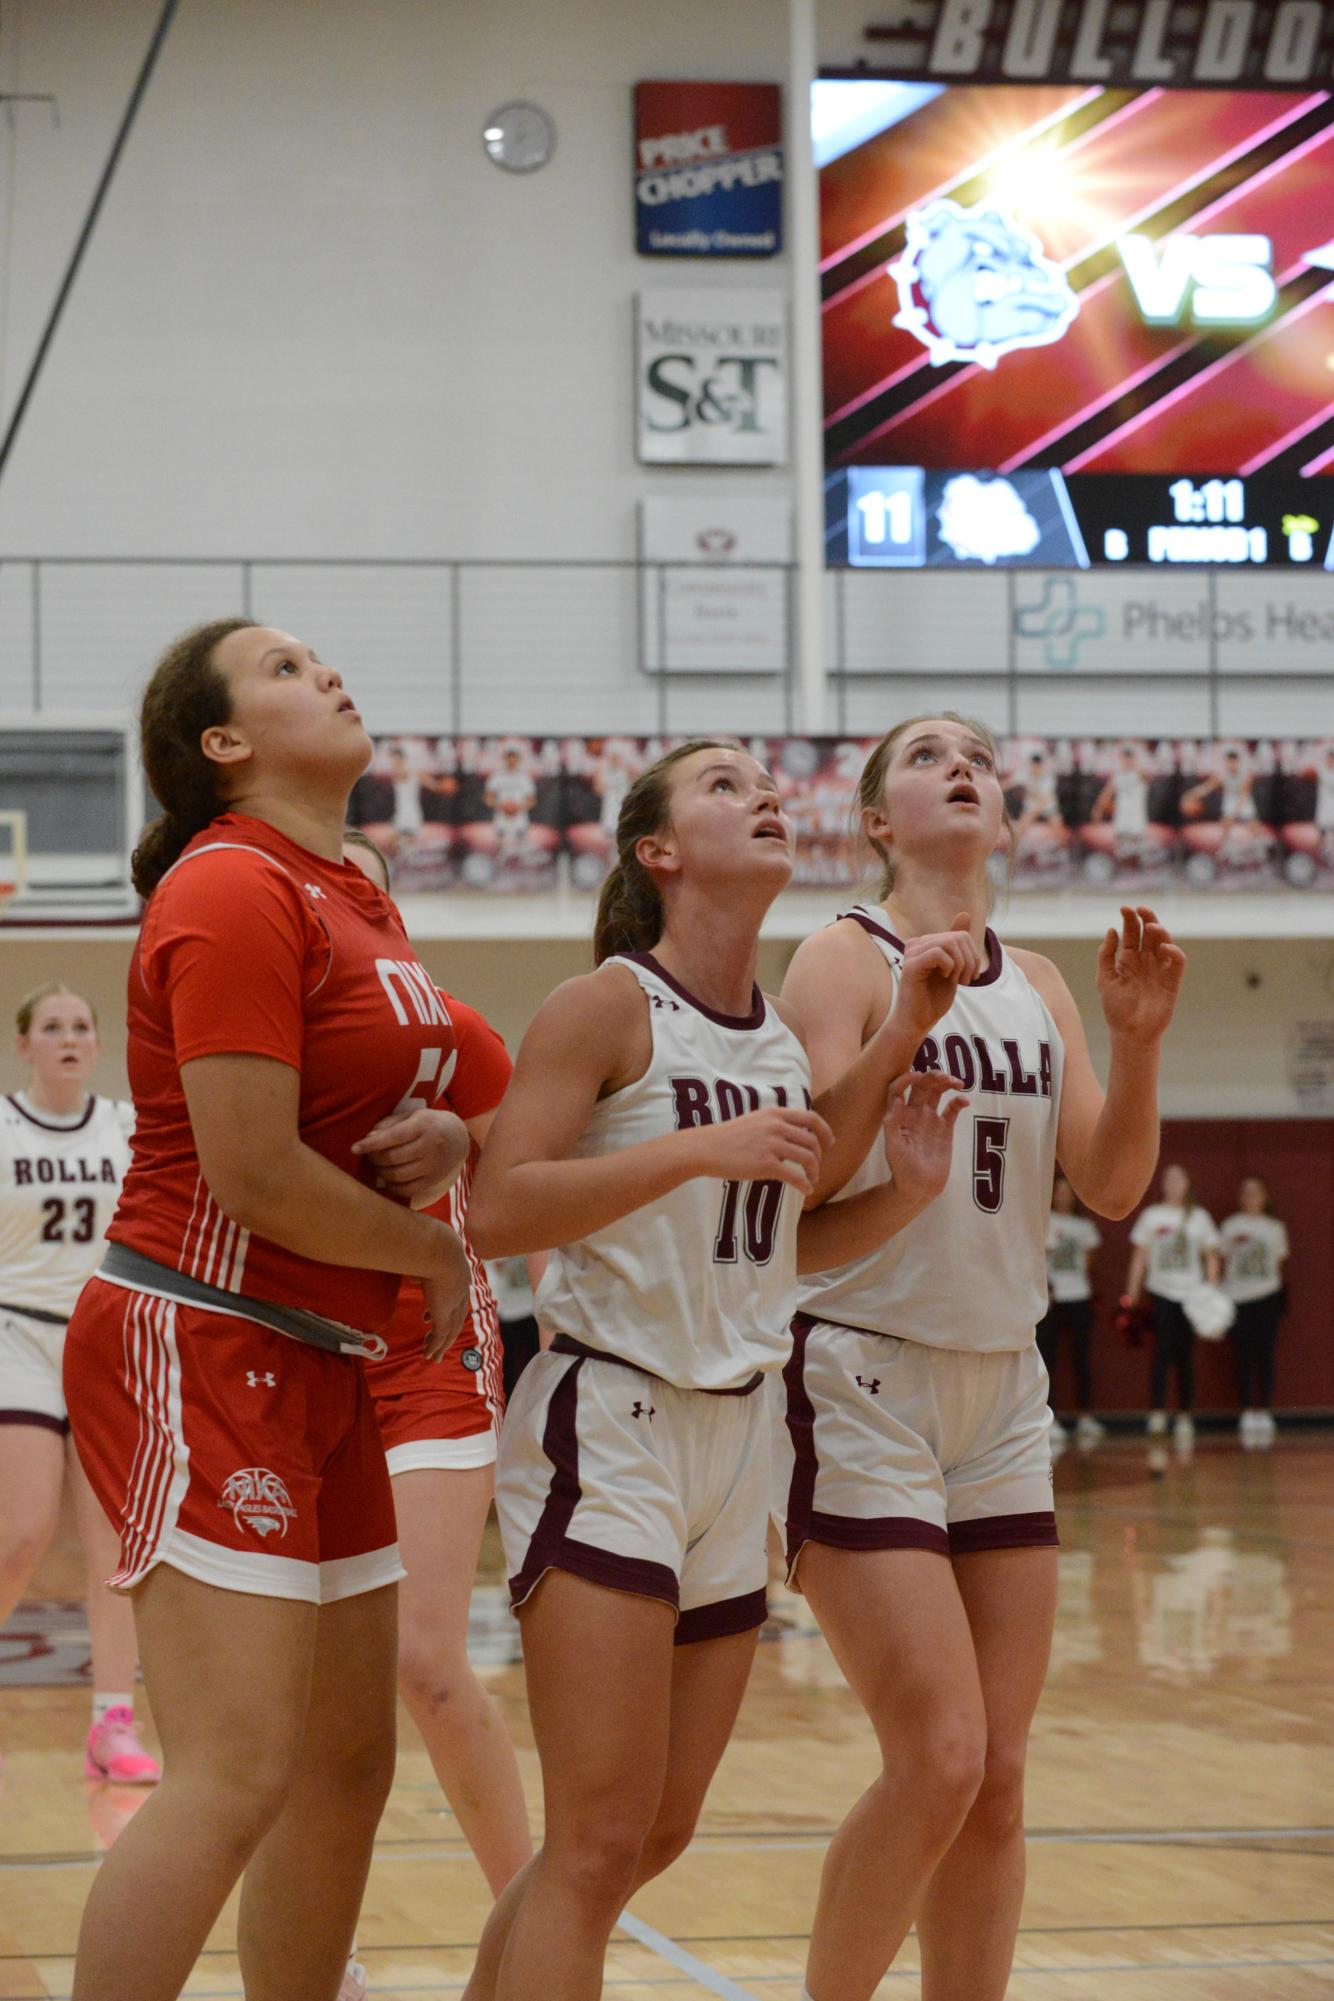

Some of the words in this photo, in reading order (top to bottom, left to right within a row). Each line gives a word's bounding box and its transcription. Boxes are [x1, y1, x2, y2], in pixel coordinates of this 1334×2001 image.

[640, 124, 728, 168] PRICE
[637, 154, 783, 205] CHOPPER
[1115, 233, 1277, 323] VS
[647, 354, 780, 433] S&T
[857, 491, 911, 544] 11
[1169, 479, 1244, 522] 1:11
[1123, 601, 1252, 648] Phelps
[375, 958, 453, 1026] NIX
[14, 1157, 117, 1186] ROLLA
[972, 1115, 1010, 1214] 5
[42, 1197, 96, 1243] 23
[713, 1179, 786, 1267] 10
